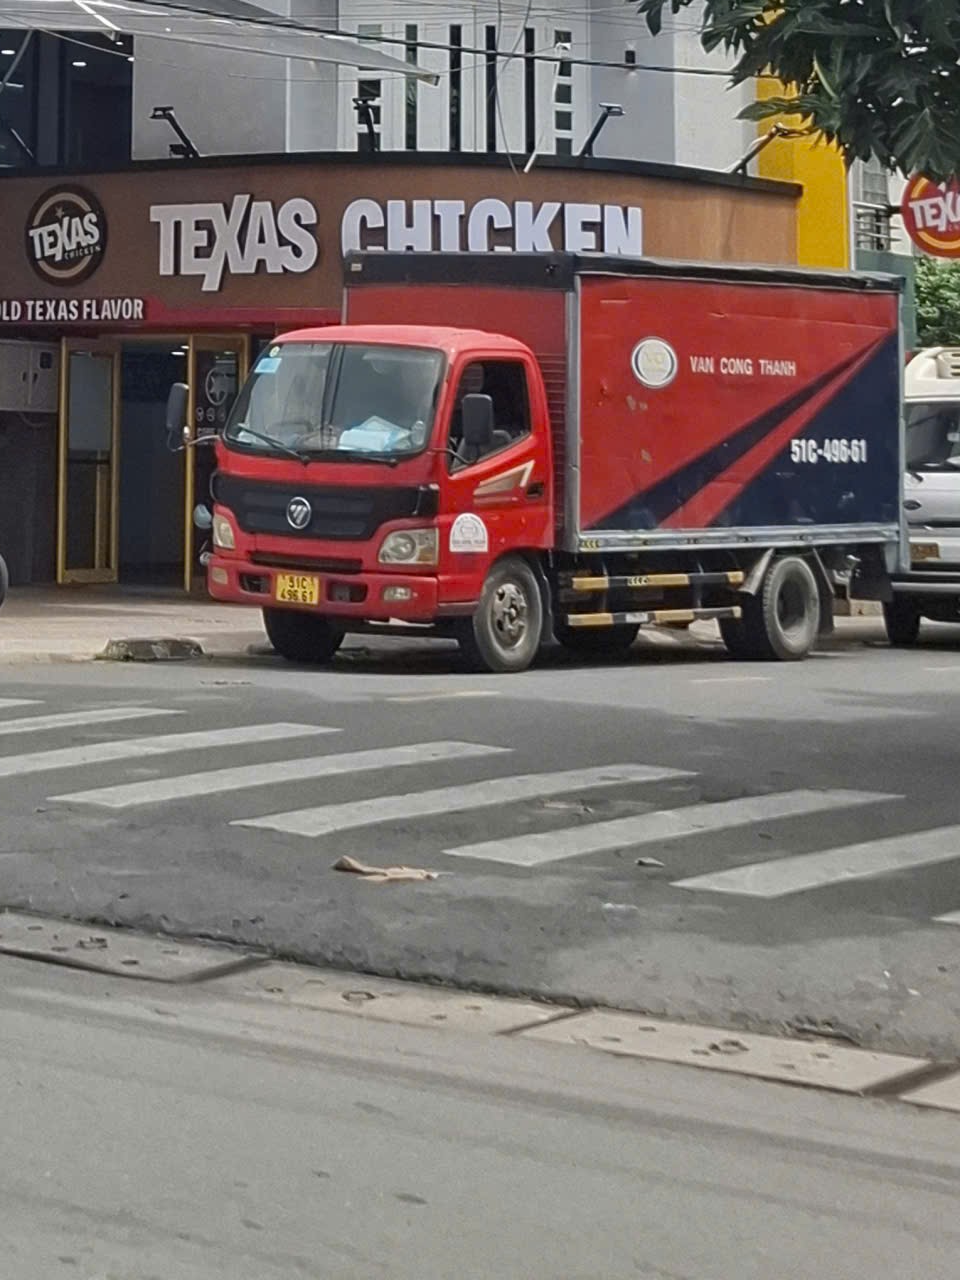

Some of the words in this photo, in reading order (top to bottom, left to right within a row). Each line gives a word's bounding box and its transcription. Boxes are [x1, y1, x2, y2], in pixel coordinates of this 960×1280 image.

[29, 212, 100, 262] TEXAS
[149, 194, 319, 291] TEXAS
[343, 198, 643, 257] CHICKEN
[25, 299, 79, 320] TEXAS
[82, 298, 144, 320] FLAVOR
[690, 356, 714, 374] VAN
[720, 357, 753, 376] CONG
[758, 359, 797, 377] THANH
